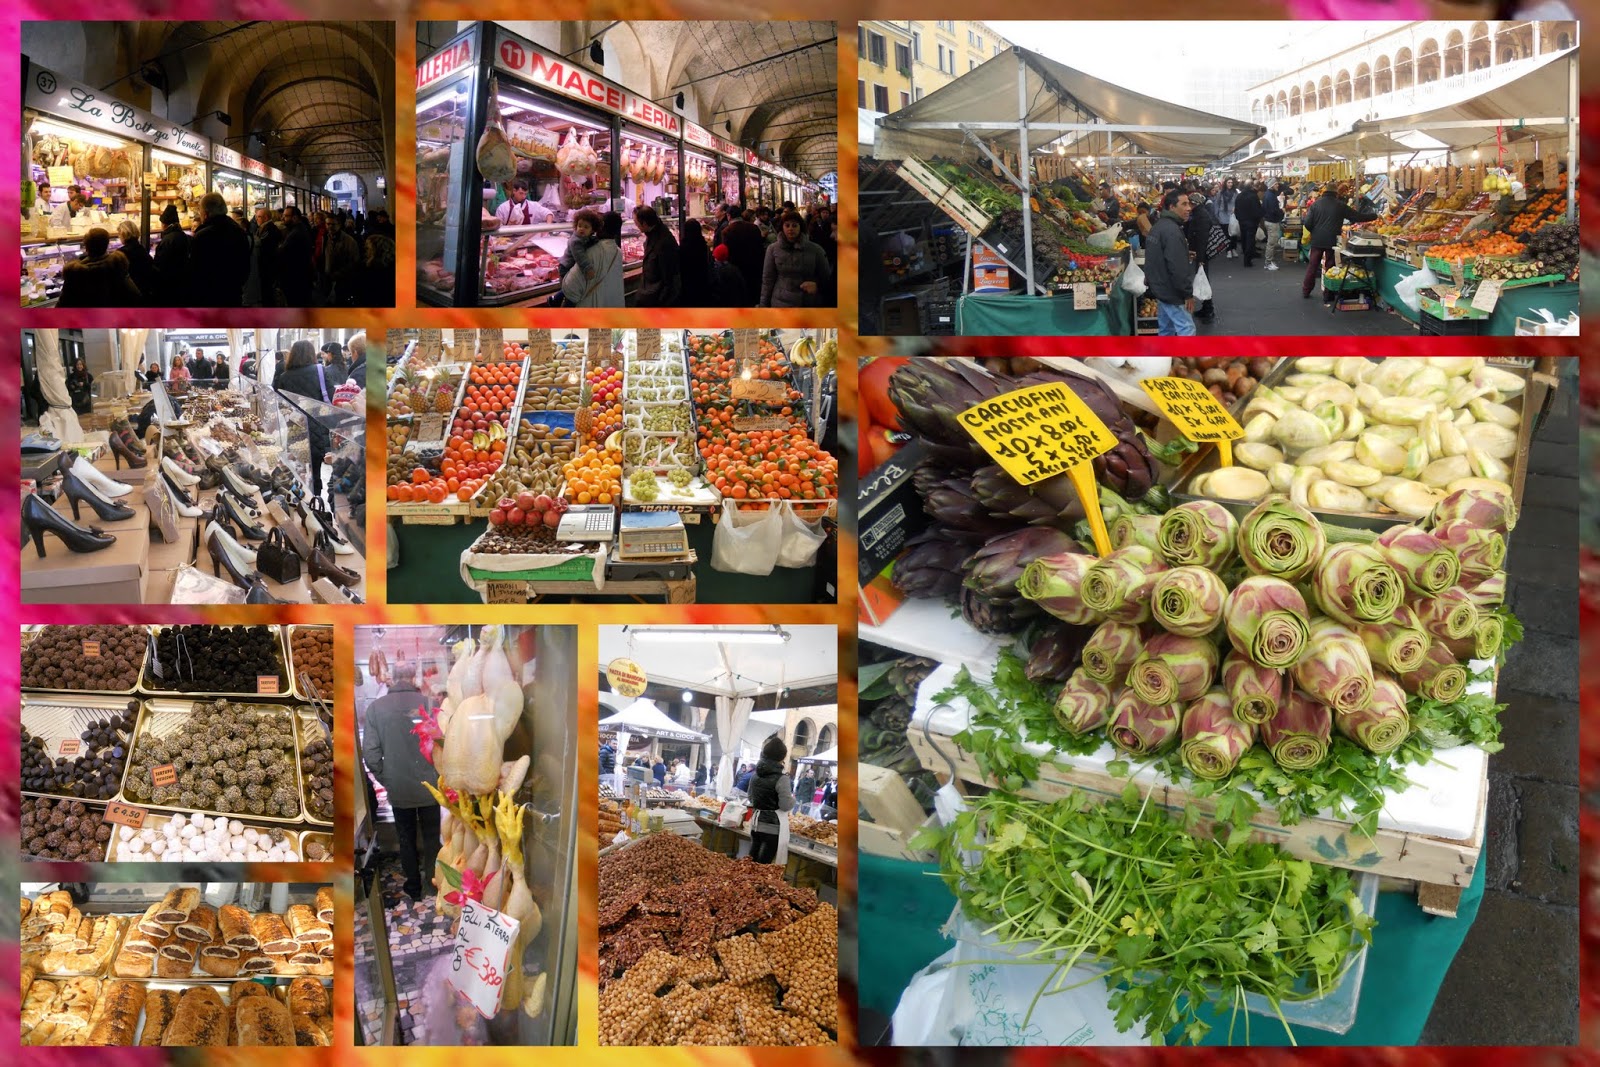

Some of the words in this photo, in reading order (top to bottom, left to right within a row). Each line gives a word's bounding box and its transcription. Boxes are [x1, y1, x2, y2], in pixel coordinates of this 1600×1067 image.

[504, 44, 522, 61] 11
[40, 76, 53, 90] 37
[531, 52, 678, 131] MACELLERIA
[68, 87, 102, 117] La
[110, 102, 168, 147] Bottga
[172, 127, 204, 152] Venet
[964, 388, 1066, 428] CARCIOFINI
[984, 402, 1070, 441] NOSTRANI
